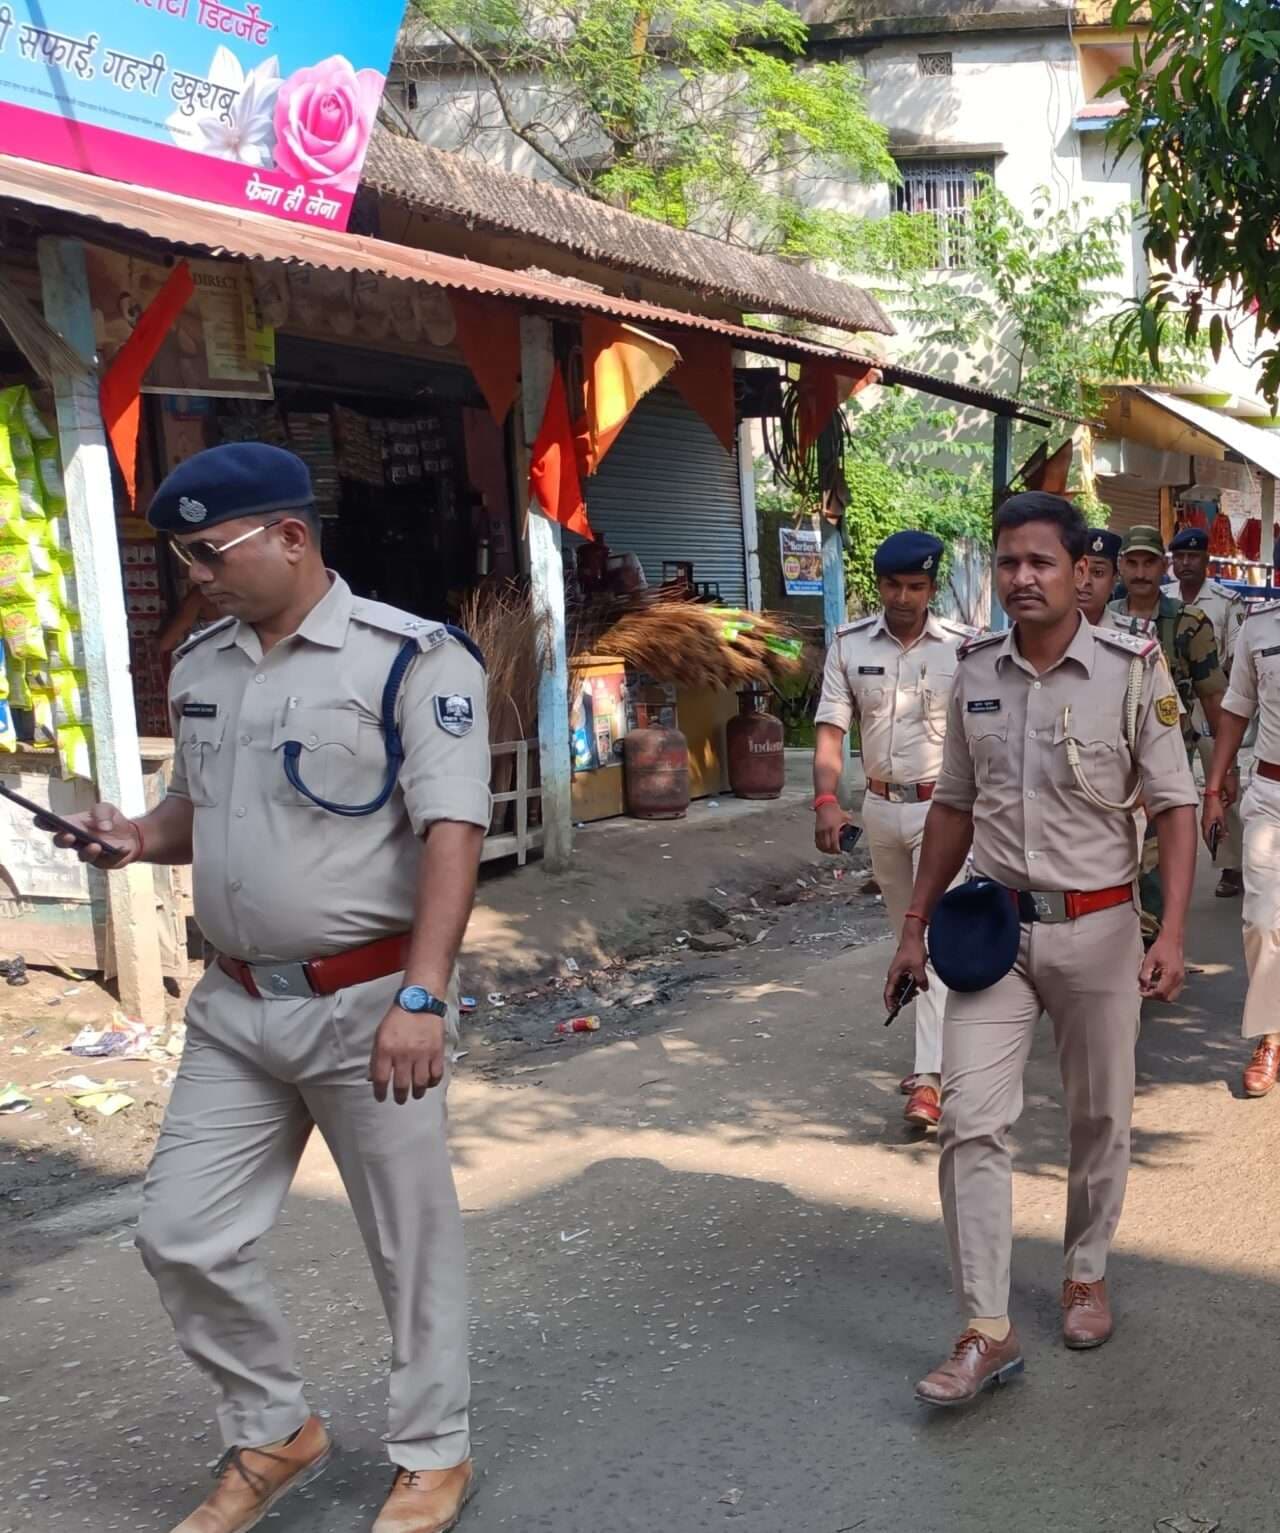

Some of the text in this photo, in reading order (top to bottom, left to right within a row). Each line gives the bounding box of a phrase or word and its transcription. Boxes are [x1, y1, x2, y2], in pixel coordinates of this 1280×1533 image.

[103, 51, 165, 94] गहरी
[171, 71, 240, 127] खुशबू
[245, 173, 342, 220] फेना ही लेना
